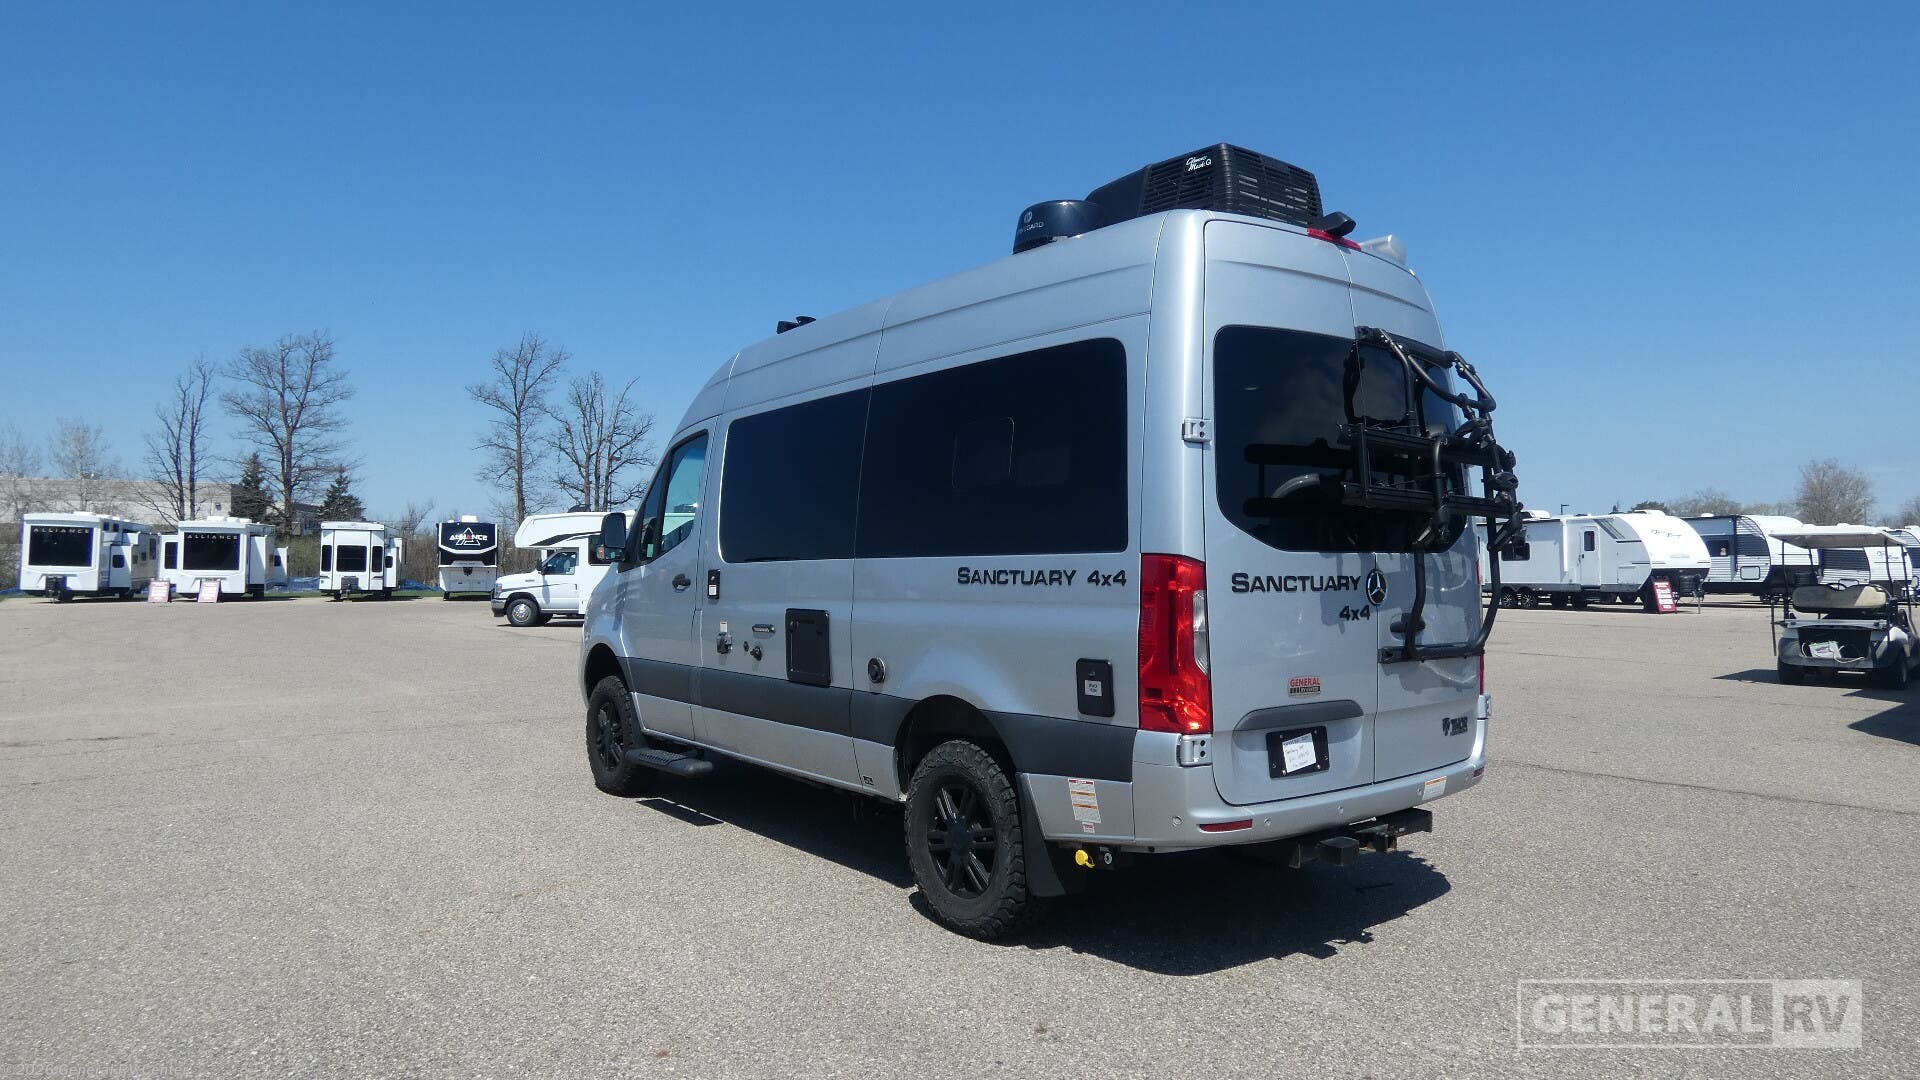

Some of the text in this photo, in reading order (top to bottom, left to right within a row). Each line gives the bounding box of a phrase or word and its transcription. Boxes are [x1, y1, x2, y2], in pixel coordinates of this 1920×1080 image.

[957, 566, 1127, 587] SANCTUARY 4x4
[1231, 572, 1362, 593] SANCTUARY
[1339, 604, 1371, 621] 4x4
[1289, 677, 1321, 687] GENERAL
